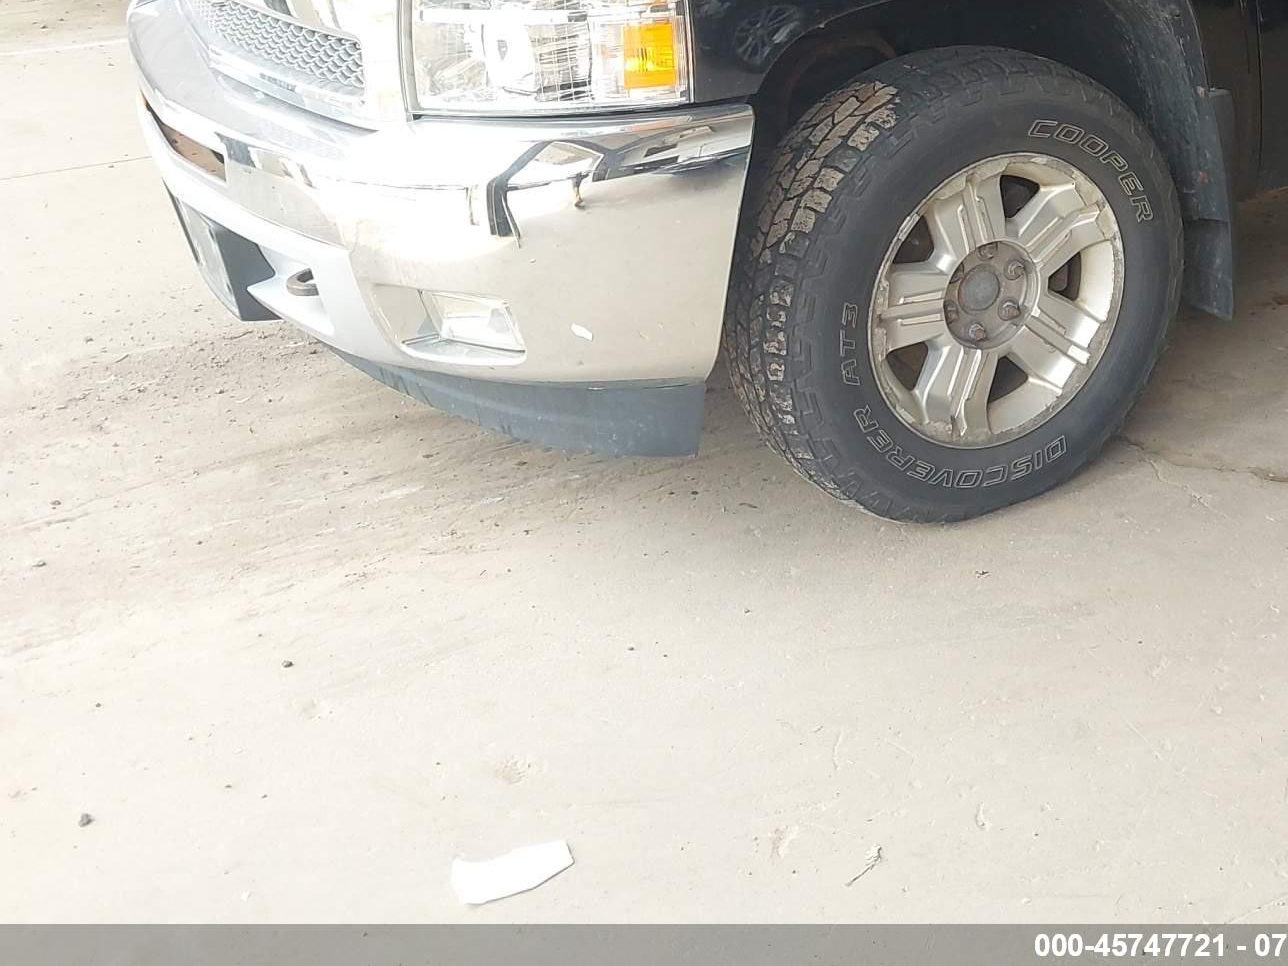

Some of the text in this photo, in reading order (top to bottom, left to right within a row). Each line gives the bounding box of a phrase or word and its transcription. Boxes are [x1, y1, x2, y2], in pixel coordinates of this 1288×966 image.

[1027, 118, 1155, 224] COOPER
[838, 301, 1069, 491] DISCOVERER AT3
